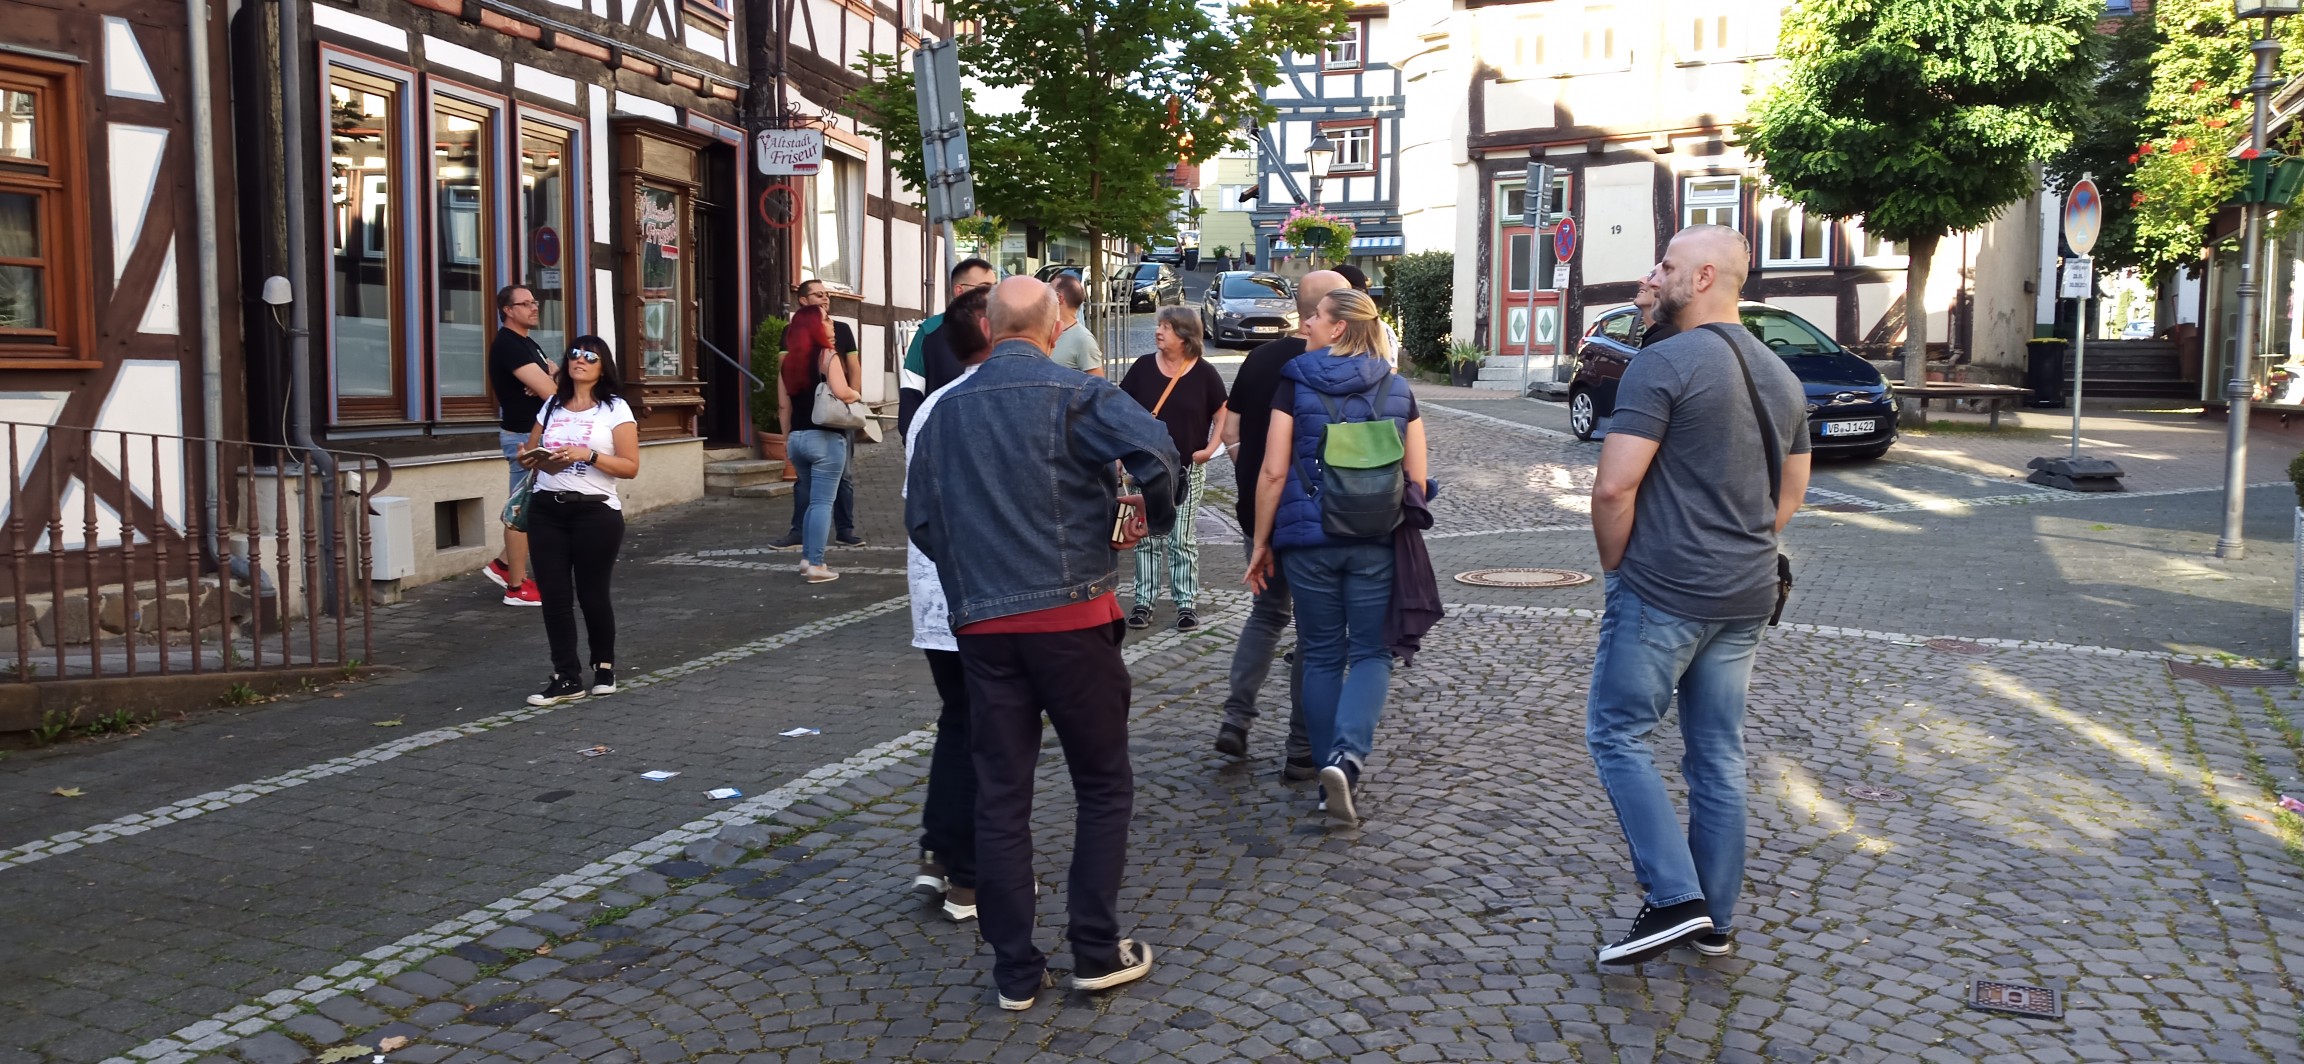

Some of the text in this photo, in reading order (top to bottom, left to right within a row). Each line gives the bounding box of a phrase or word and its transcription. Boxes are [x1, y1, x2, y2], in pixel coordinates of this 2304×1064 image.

[766, 134, 811, 149] Altstadt
[770, 142, 818, 164] Friseur
[1611, 224, 1622, 235] 19
